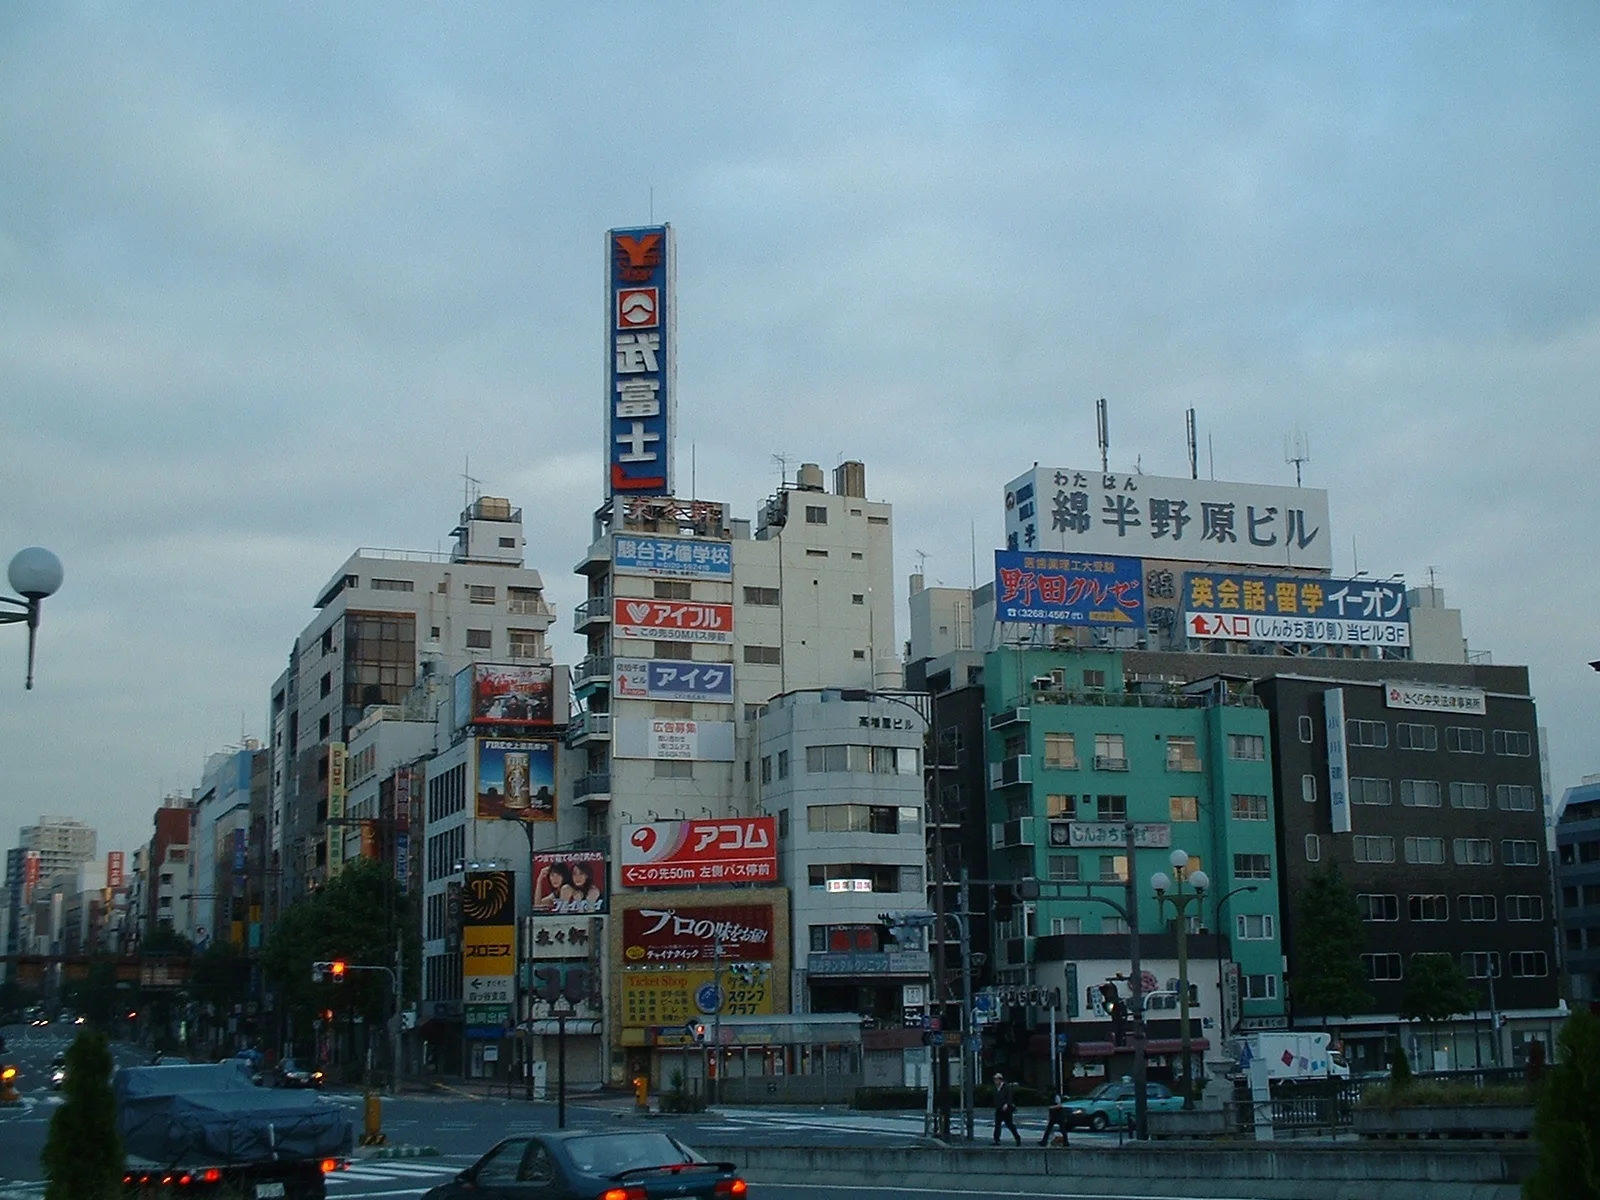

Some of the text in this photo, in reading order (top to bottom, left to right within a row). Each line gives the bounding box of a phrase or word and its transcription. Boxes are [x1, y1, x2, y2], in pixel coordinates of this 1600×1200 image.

[616, 333, 660, 462] 武富士
[1052, 489, 1320, 550] 綿半野原ビル
[617, 540, 729, 565] 駿台予備学校
[999, 567, 1140, 608] 野田クルゼ
[1191, 577, 1323, 614] 英会話・留学
[1328, 585, 1403, 618] イーオン
[654, 605, 722, 628] アイフル
[1212, 615, 1250, 637] 入口
[656, 667, 724, 690] アイク
[653, 722, 697, 734] 広告募集
[694, 822, 769, 852] アコム
[637, 864, 770, 881] この先50m 左側バス停前
[466, 944, 511, 957] プロミス
